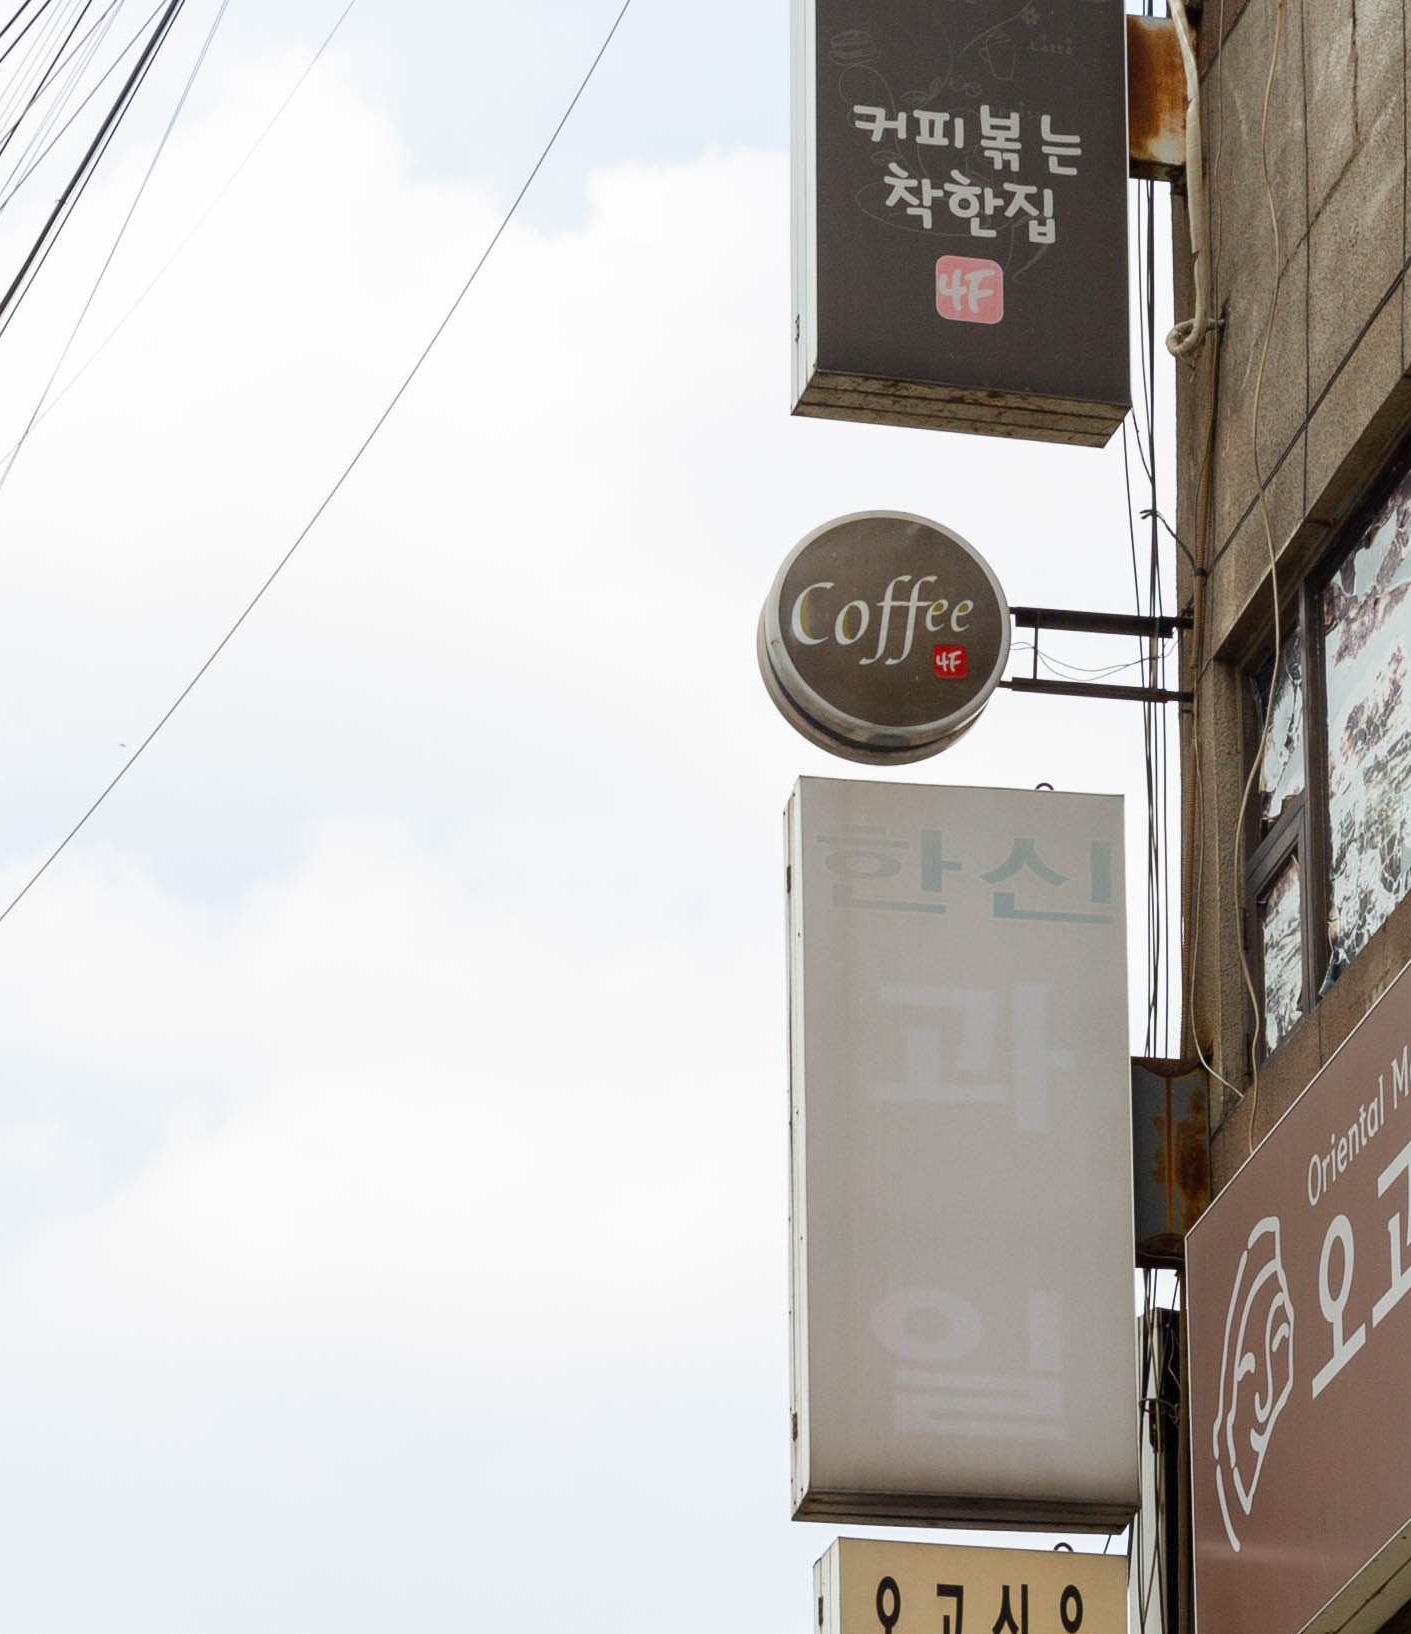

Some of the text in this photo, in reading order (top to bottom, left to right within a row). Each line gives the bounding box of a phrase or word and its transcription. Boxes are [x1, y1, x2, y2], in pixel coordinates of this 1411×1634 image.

[853, 104, 1082, 176] 커피 볶는
[884, 162, 1056, 244] 착한집
[939, 268, 995, 314] 4F
[791, 575, 974, 666] Coffee
[935, 650, 963, 673] 4F
[1306, 1088, 1385, 1207] Oriental
